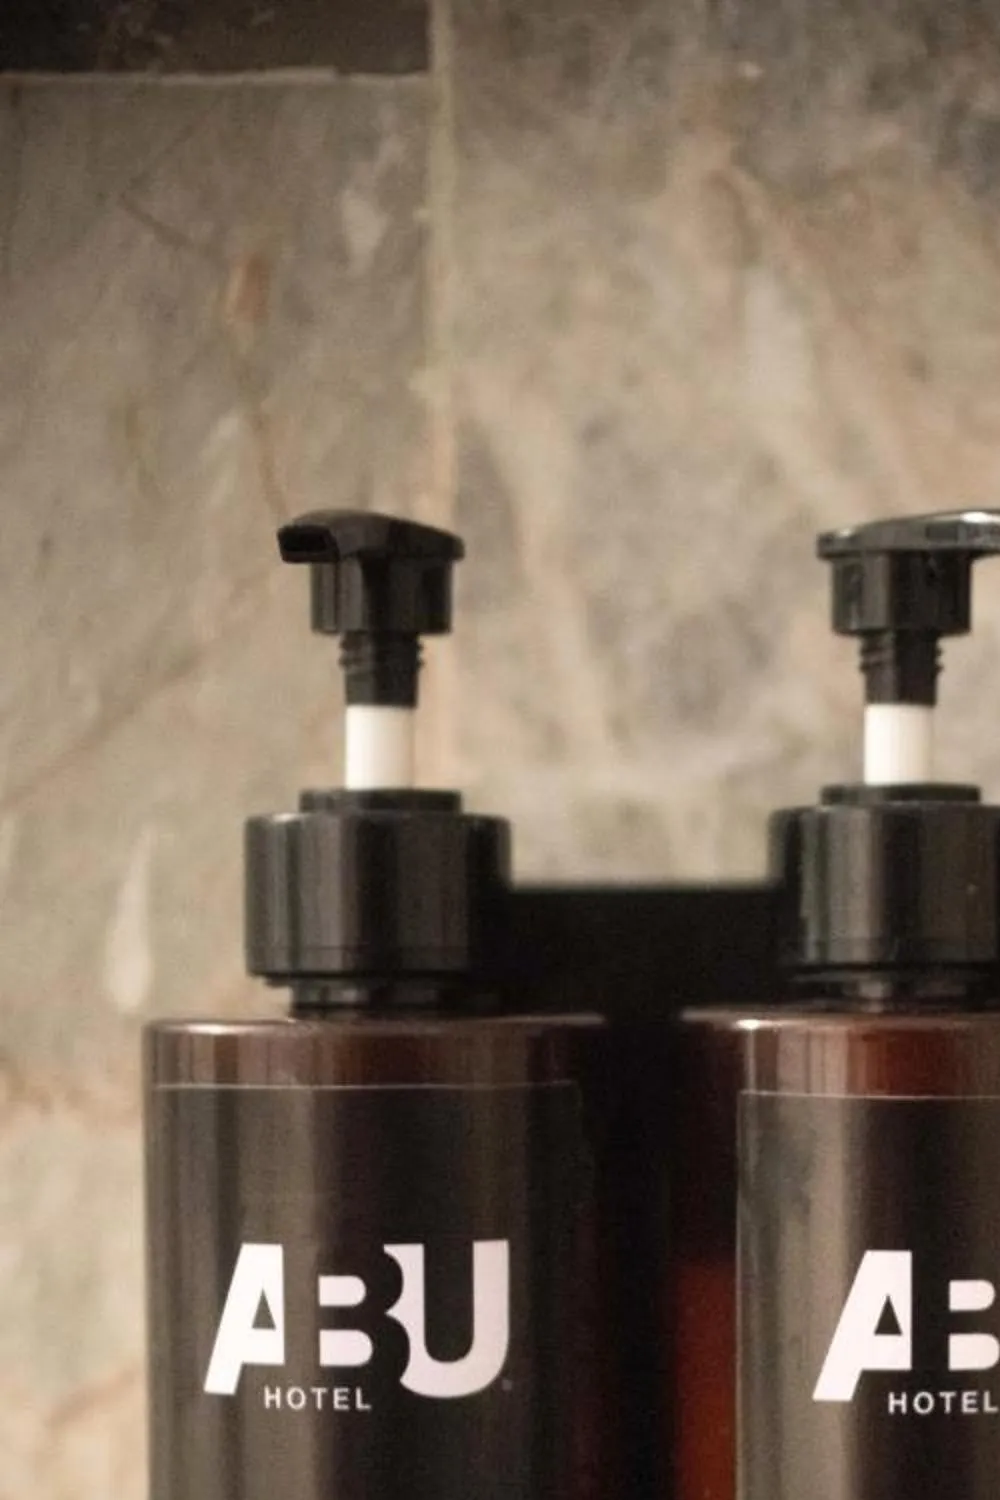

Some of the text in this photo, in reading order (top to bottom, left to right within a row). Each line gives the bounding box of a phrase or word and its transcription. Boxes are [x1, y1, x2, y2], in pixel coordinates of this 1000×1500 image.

[203, 1239, 511, 1399] ABU
[264, 1385, 372, 1412] HOTEL
[887, 1390, 999, 1416] HOTEL
